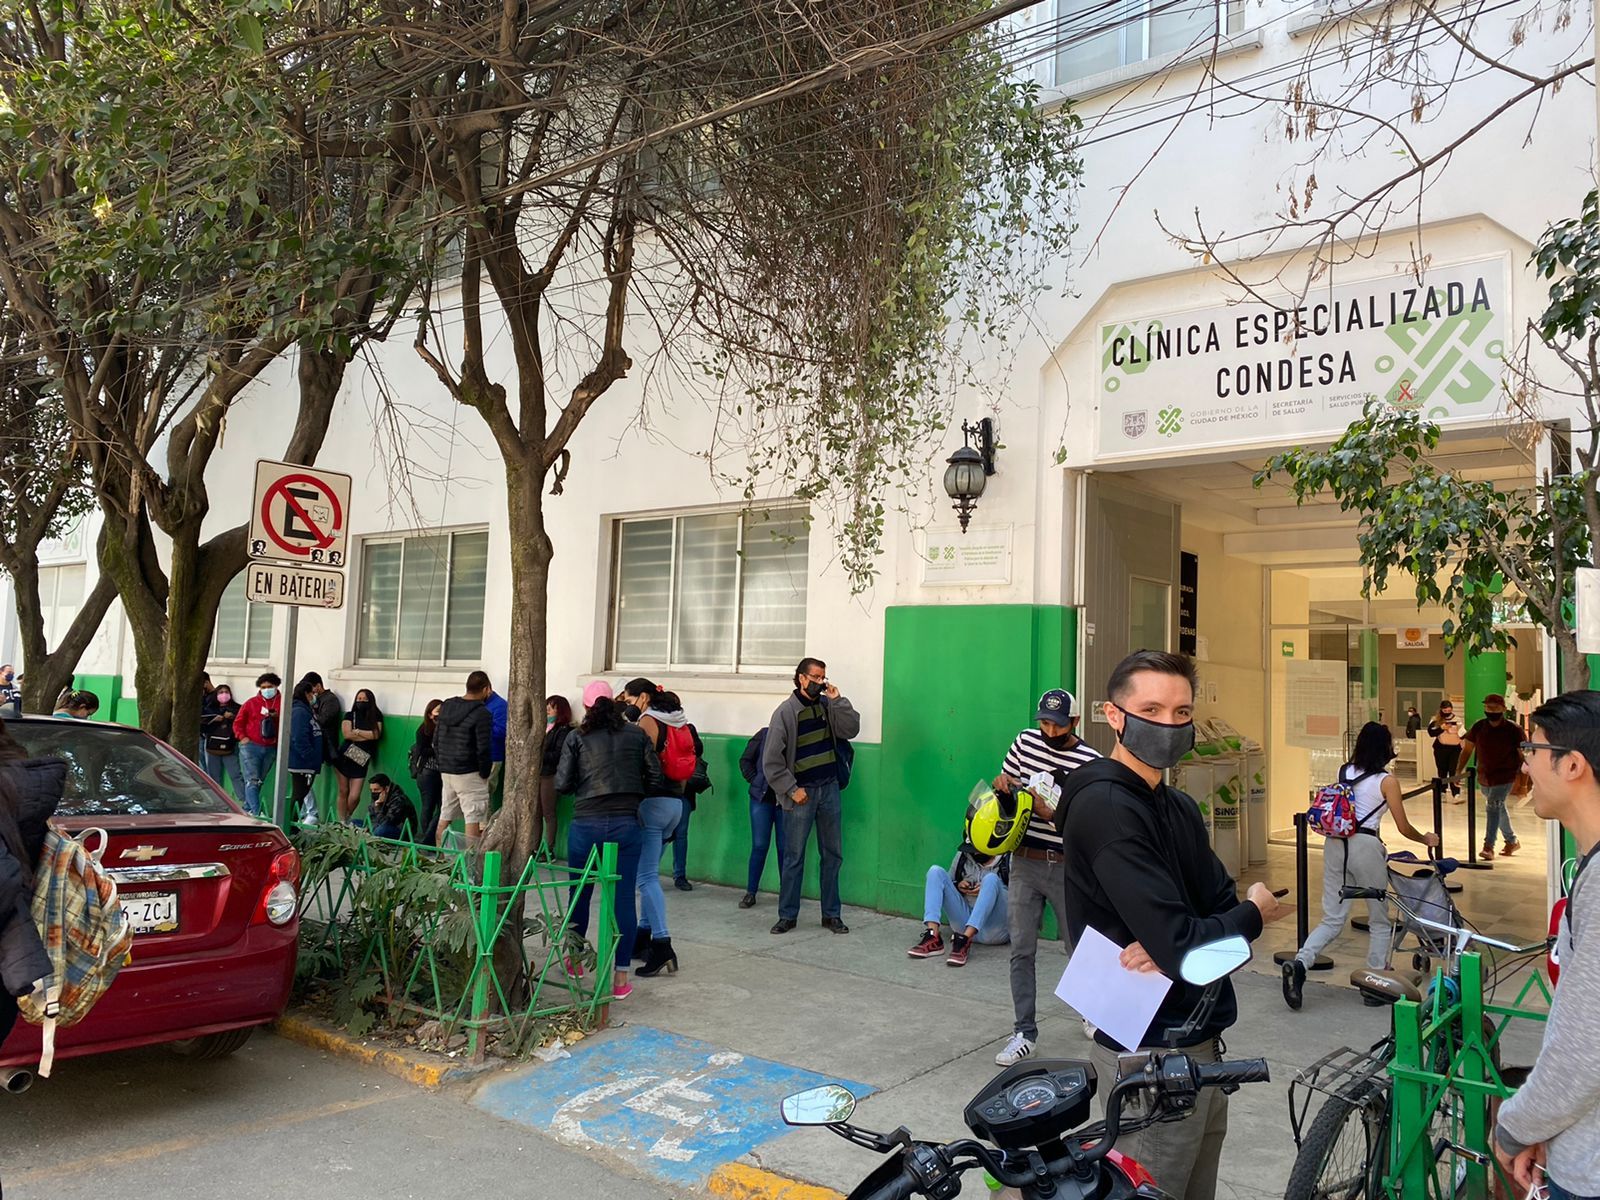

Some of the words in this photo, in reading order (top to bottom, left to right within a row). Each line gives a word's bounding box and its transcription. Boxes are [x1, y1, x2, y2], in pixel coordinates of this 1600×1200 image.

[1112, 322, 1221, 367] CLÍNICA
[1236, 277, 1491, 348] ESPECIALIZADA
[1216, 350, 1357, 398] CONDESA
[1329, 392, 1362, 402] SERVICIOS
[1190, 407, 1232, 418] GOBIERNO
[1235, 405, 1245, 413] DE
[1248, 404, 1259, 412] LA
[1283, 407, 1305, 415] SALUD
[1329, 401, 1350, 409] SALUD
[1190, 416, 1217, 425] CIUDAD
[1219, 414, 1228, 422] DE
[1230, 411, 1259, 420] MÉXICO
[255, 571, 273, 594] EN
[280, 574, 329, 599] BATERI
